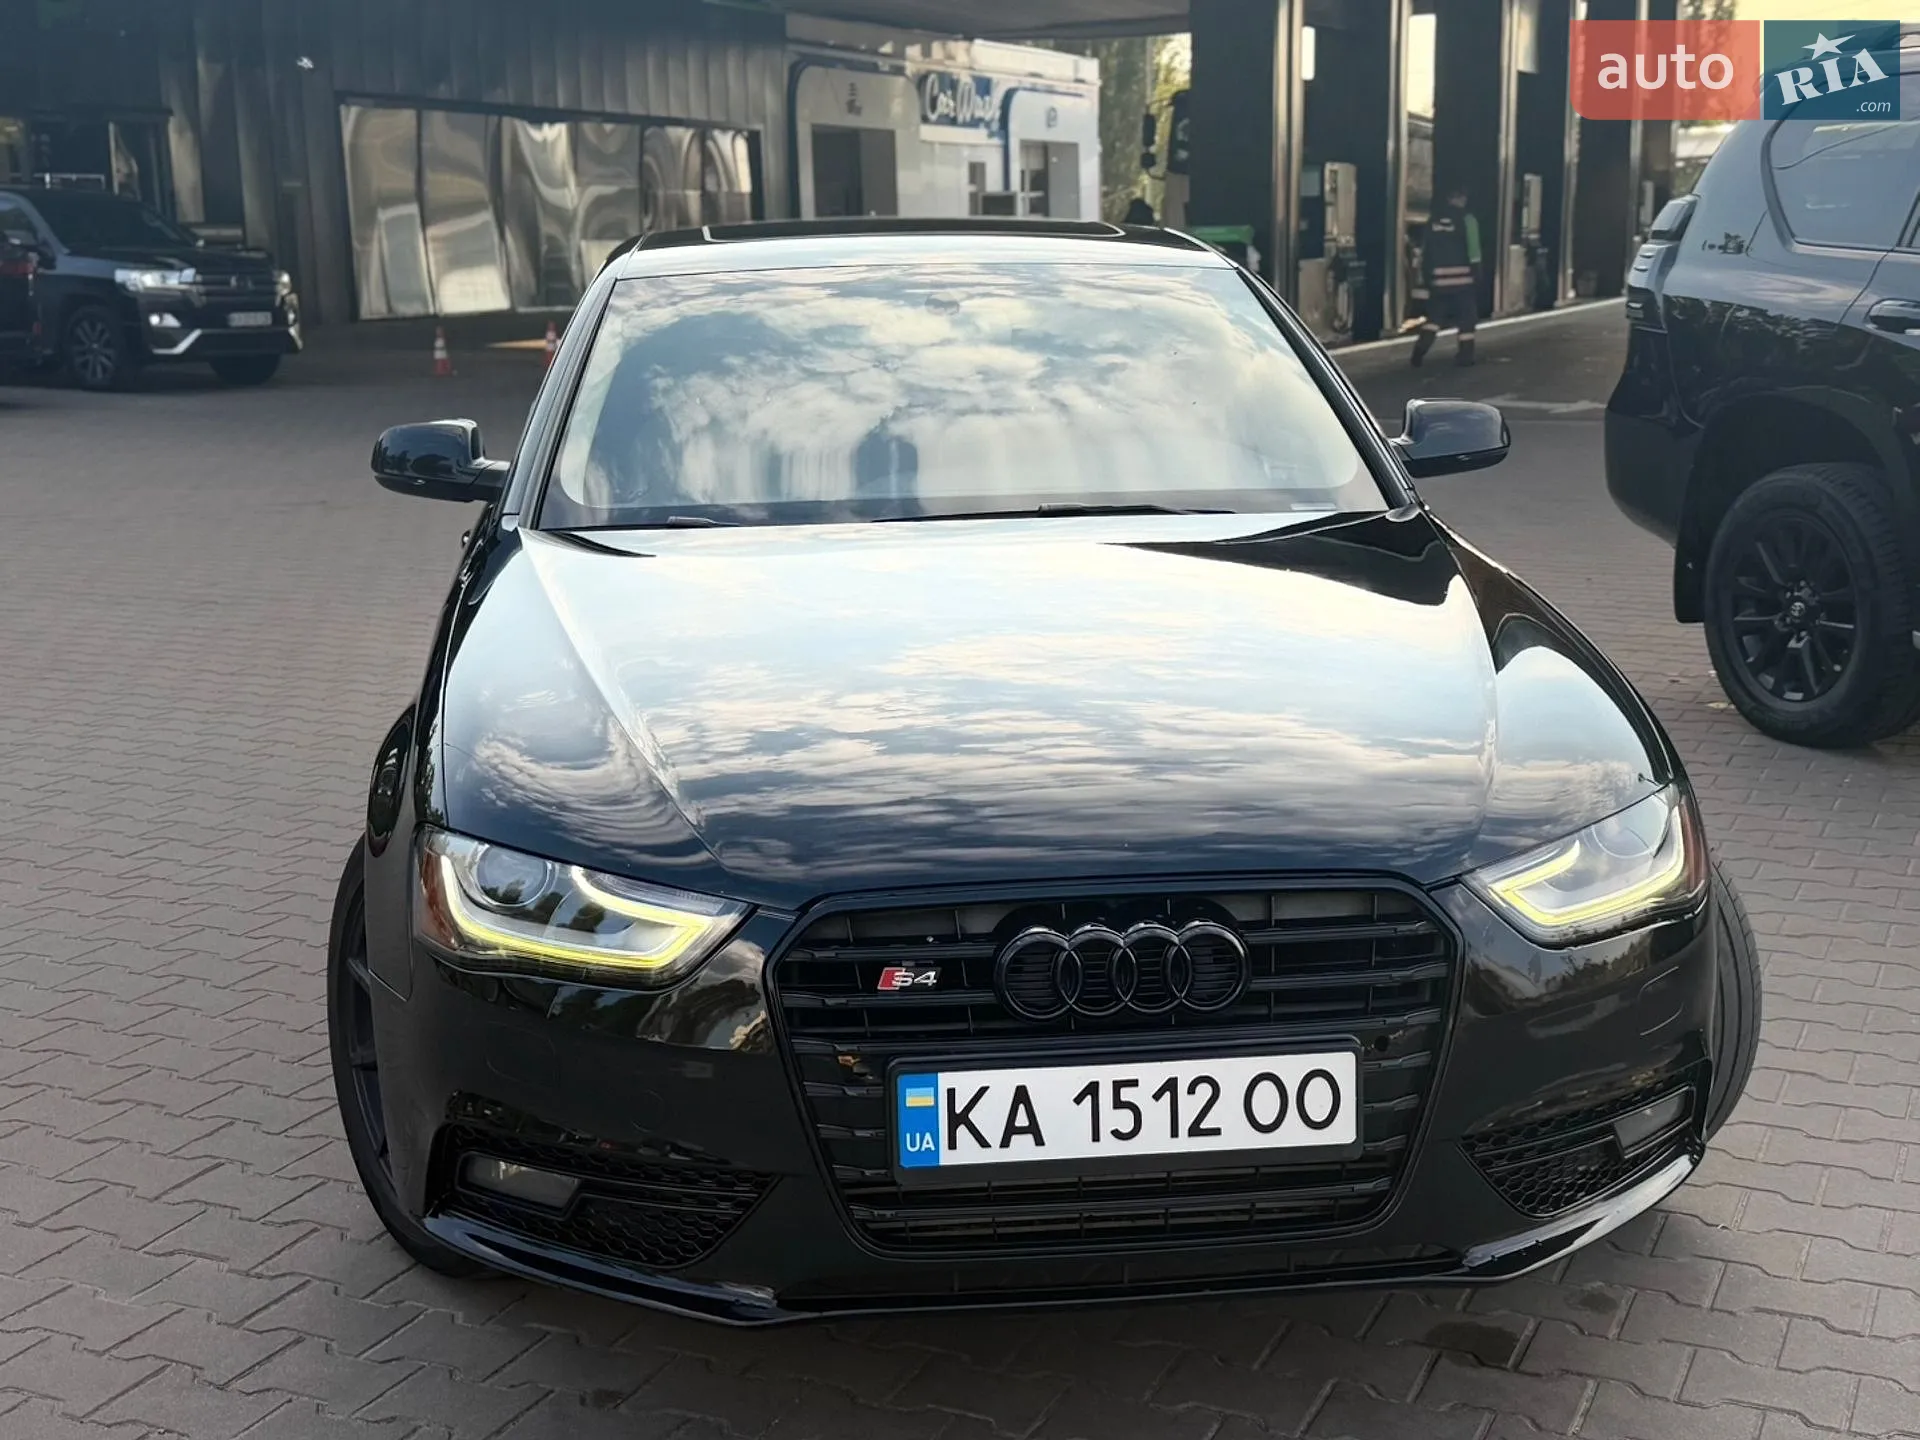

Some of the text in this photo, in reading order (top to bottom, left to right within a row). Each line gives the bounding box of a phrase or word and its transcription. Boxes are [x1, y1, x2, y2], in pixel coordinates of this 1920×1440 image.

[925, 73, 956, 122] Car
[891, 970, 938, 988] S4
[946, 1068, 1341, 1151] KA 1512 OO
[906, 1132, 935, 1152] UA
